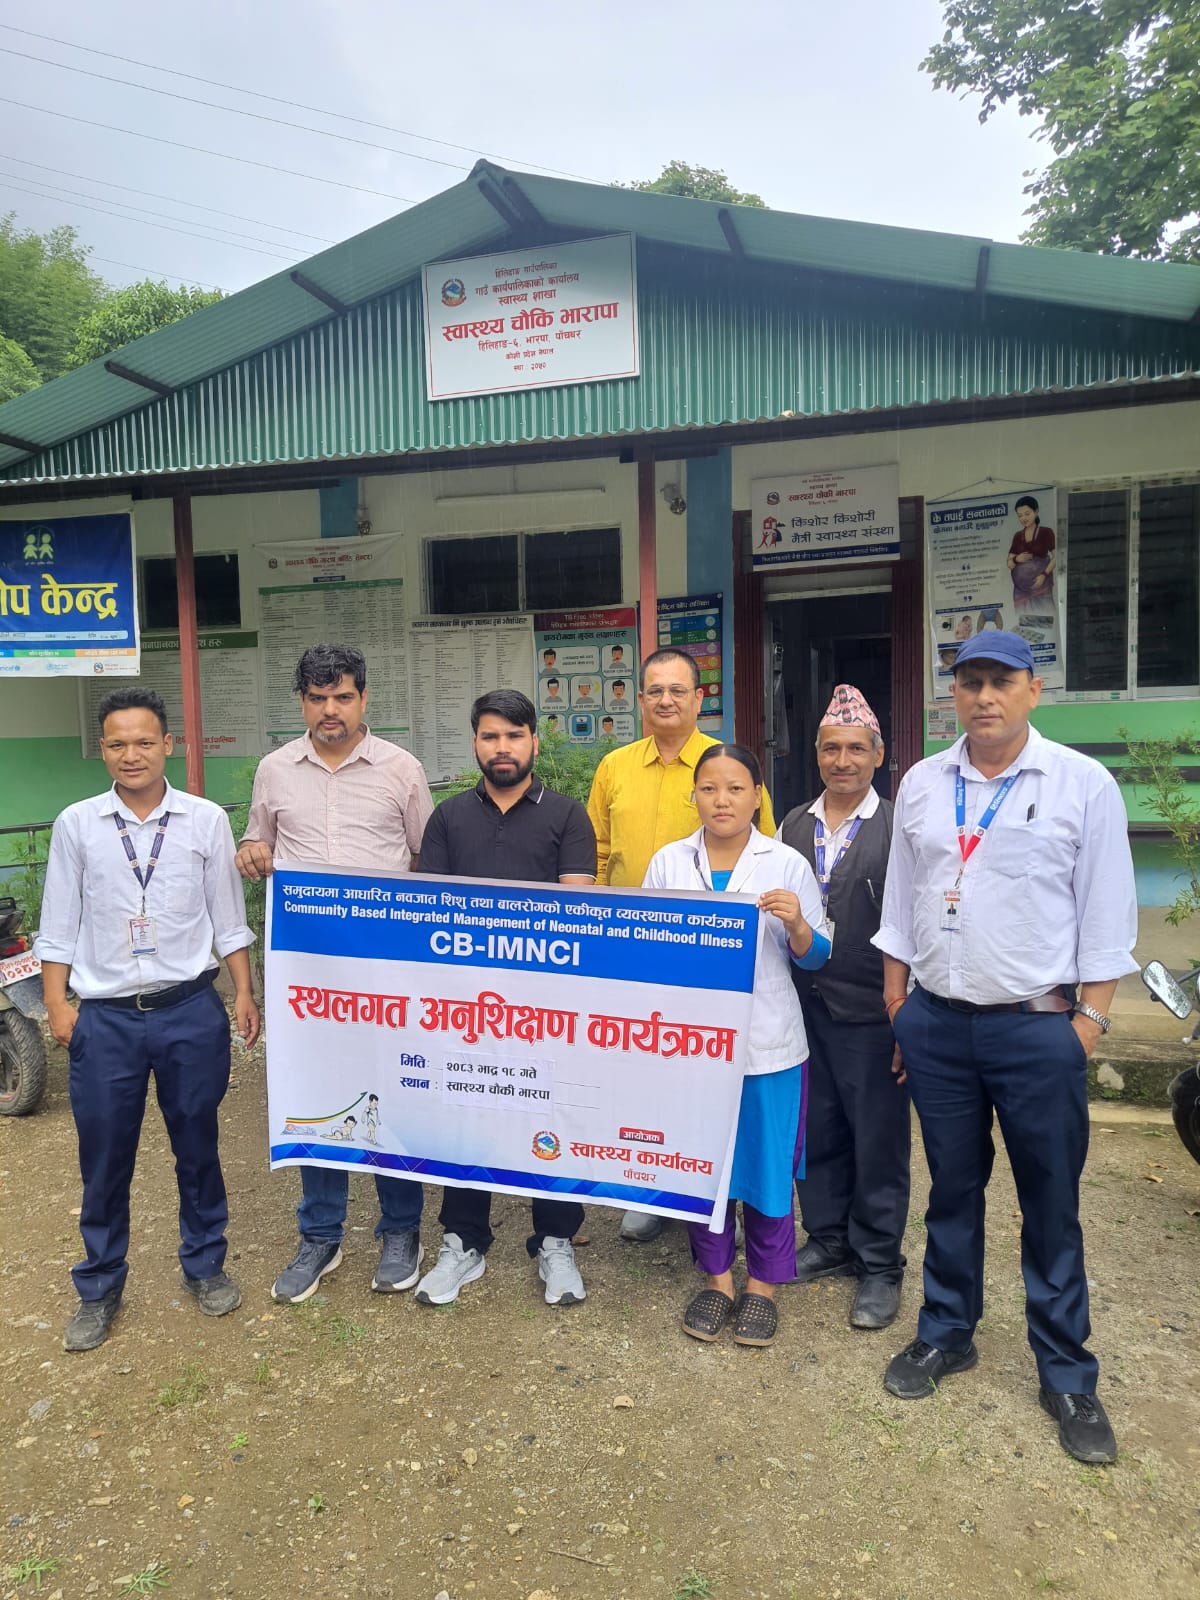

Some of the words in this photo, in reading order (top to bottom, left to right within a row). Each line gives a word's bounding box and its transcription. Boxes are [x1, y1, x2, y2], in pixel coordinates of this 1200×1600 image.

[493, 276, 544, 293] कार्यपालिकाको
[549, 272, 579, 285] कार्यालय
[498, 293, 528, 306] स्वास्थ्य
[533, 289, 556, 301] शाखा
[442, 318, 505, 342] स्वास्थ्य
[511, 307, 554, 330] चौकि
[560, 302, 619, 324] भारापा
[791, 515, 829, 528] किशोर
[834, 509, 876, 524] किशोरी
[816, 529, 858, 542] स्वास्थ्य
[862, 525, 894, 538] संस्था
[0, 577, 31, 616] ोप
[40, 573, 119, 620] केन्द्र
[282, 884, 339, 899] समुदायमा
[343, 887, 391, 902] आधारित
[395, 892, 437, 905] नवजात
[440, 892, 467, 910] शिशु
[470, 897, 494, 909] तथा
[497, 897, 560, 914] बालरोगको
[565, 904, 612, 921] एकीकृत
[616, 908, 683, 924] व्यवस्थापन
[687, 914, 745, 930] कार्यक्रम
[284, 900, 348, 919] Community
[351, 906, 387, 919] Based
[390, 908, 450, 924] Integrated
[453, 914, 530, 930] Management
[533, 918, 546, 930] of
[550, 921, 603, 936] Neonatal
[607, 926, 629, 939] and
[634, 927, 696, 945] Childhood
[700, 933, 743, 949] Illness
[430, 930, 580, 966] CB-IMNCI
[288, 985, 411, 1029] स्थलगत
[419, 991, 578, 1045] अनुशिक्षण
[587, 1011, 737, 1064] कार्यक्रम
[478, 1064, 498, 1076] भाद्र
[502, 1067, 516, 1077] १८
[520, 1066, 537, 1079] गते
[446, 1081, 485, 1094] स्वास्थ्य
[489, 1082, 515, 1097] चौकी
[518, 1088, 550, 1101] भारपा
[623, 1131, 660, 1143] आयोजक
[569, 1141, 632, 1162] स्वास्थ्य
[637, 1150, 714, 1176] कार्यालय
